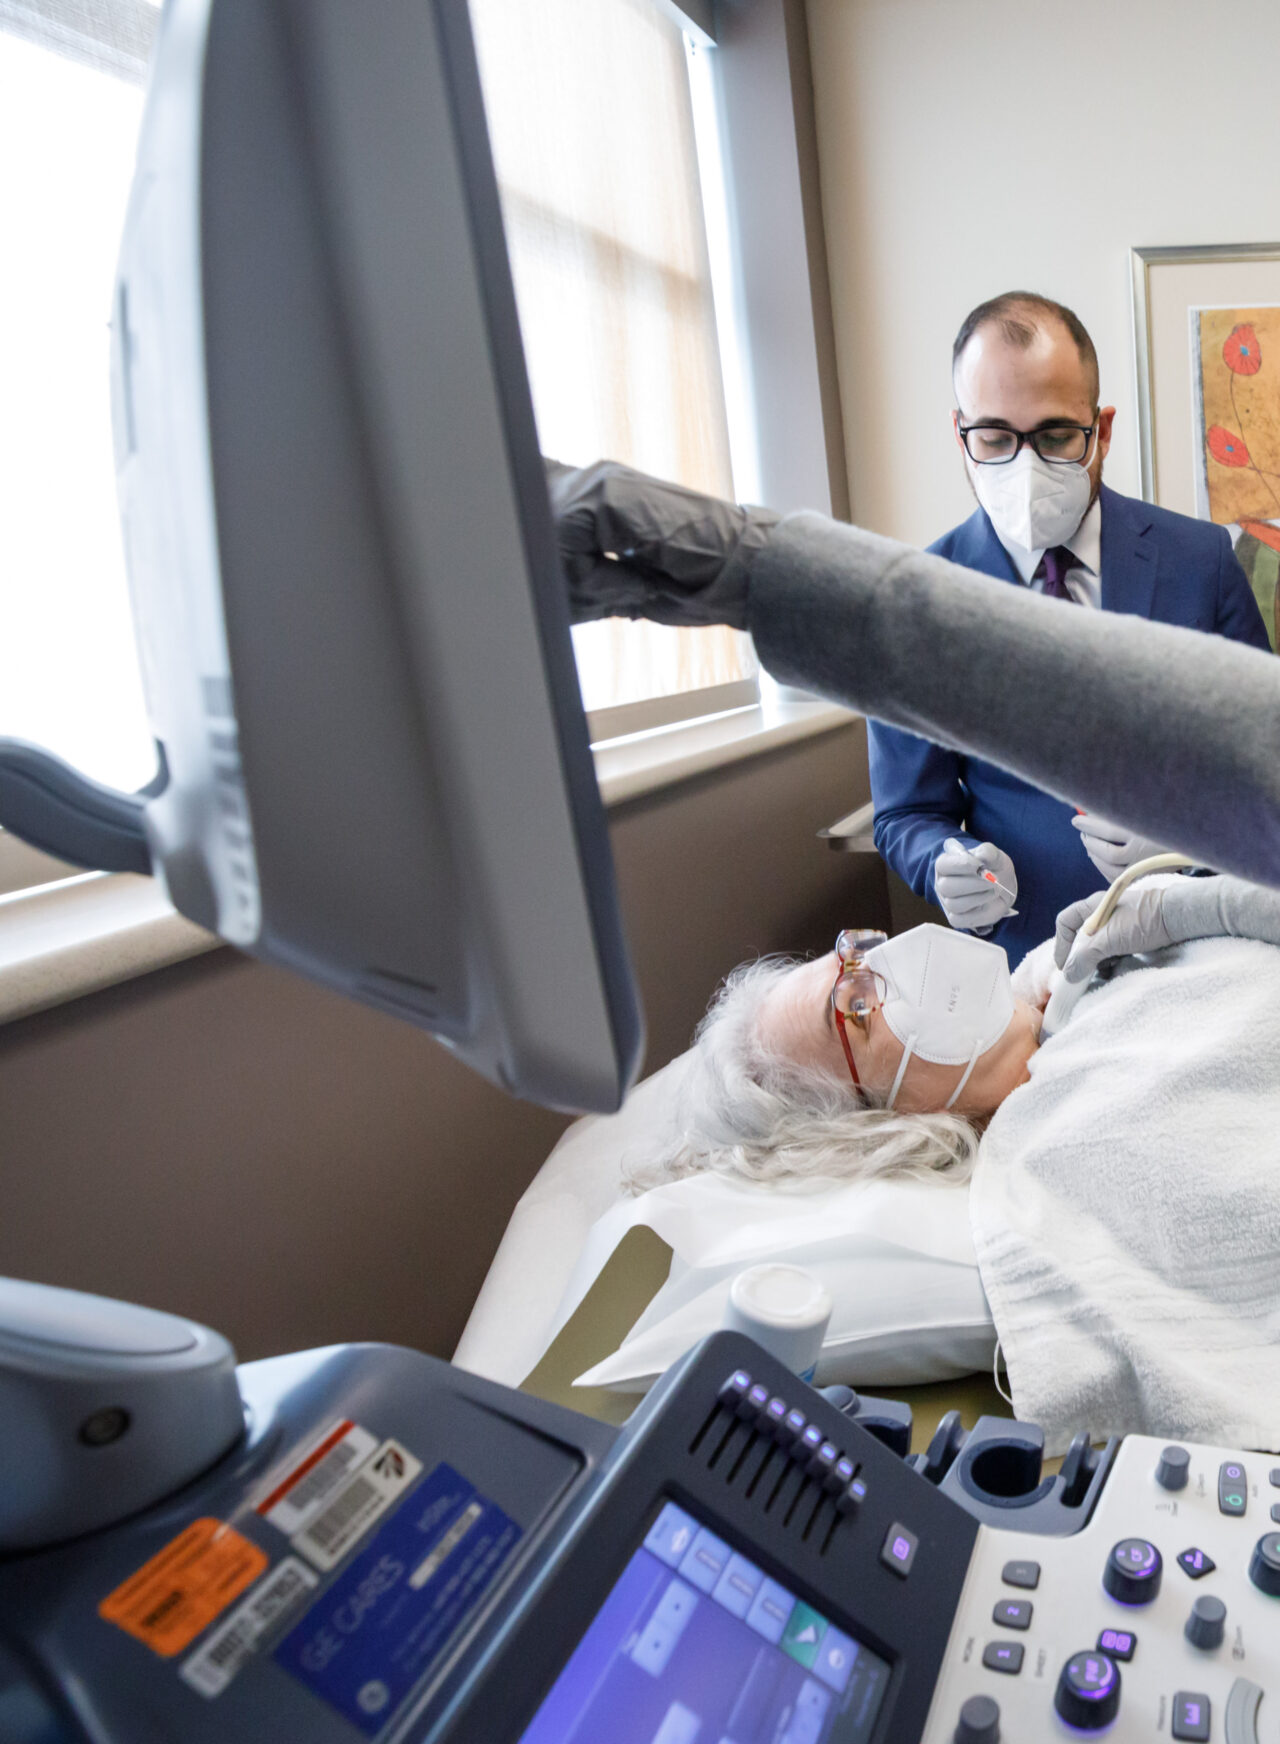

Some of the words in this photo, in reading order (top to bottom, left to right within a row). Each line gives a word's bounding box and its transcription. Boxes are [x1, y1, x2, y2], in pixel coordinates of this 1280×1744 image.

[301, 1627, 344, 1672] GE
[332, 1554, 404, 1634] CARES
[1006, 1605, 1020, 1617] 2
[997, 1648, 1011, 1660] 1
